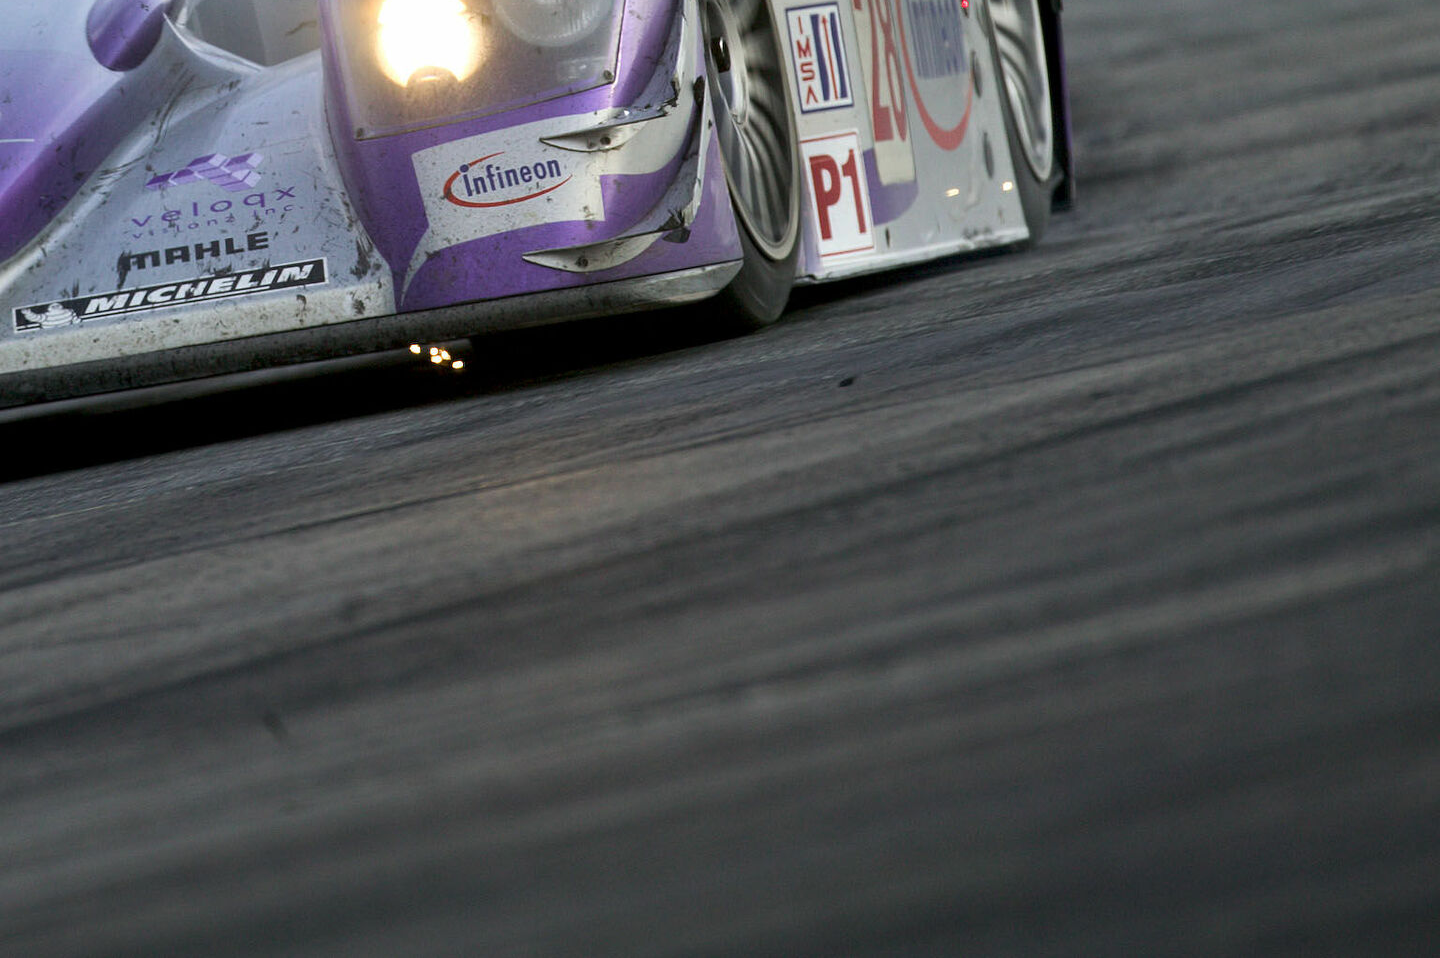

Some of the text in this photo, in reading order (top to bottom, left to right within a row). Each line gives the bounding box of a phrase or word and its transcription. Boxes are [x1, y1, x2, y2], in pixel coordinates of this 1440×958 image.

[796, 16, 818, 104] IMSA
[131, 186, 296, 228] veloqx
[809, 148, 867, 241] P1
[121, 231, 269, 270] MAHLE
[84, 264, 314, 314] MICHELIN
